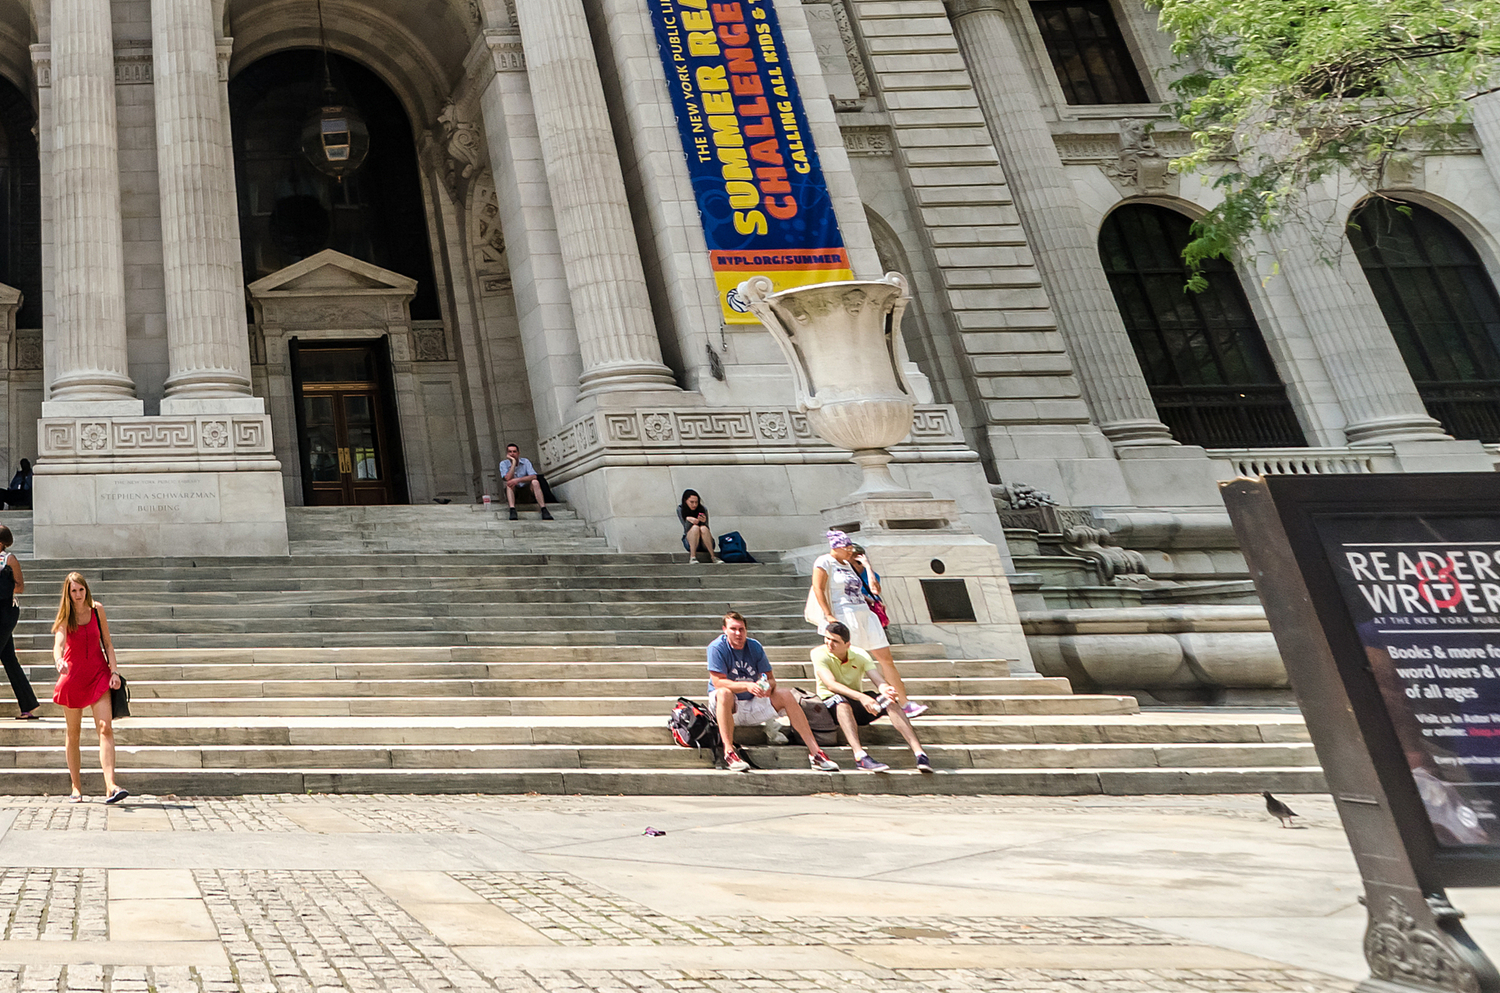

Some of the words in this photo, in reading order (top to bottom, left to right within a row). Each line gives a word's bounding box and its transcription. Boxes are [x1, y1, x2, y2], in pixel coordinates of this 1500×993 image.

[751, 7, 766, 20] &
[664, 17, 685, 61] PUBLIC
[755, 23, 779, 63] KIDS
[676, 65, 695, 99] YORK
[768, 66, 788, 97] ALL
[686, 102, 705, 133] NEW
[711, 2, 798, 220] CHALLENGE
[694, 137, 712, 163] THE
[696, 65, 768, 236] SUMMER
[777, 101, 811, 174] CALLING
[717, 254, 842, 265] NYPL.ORG/SUMMER
[151, 492, 216, 500] SCHWARZMAN
[1374, 617, 1387, 625] AT
[1389, 617, 1411, 625] THE
[1413, 617, 1437, 625] NEW
[1440, 616, 1470, 624] YORK
[1387, 644, 1433, 659] Books
[1432, 645, 1448, 659] &
[1447, 647, 1487, 659] more
[1395, 664, 1436, 679] word
[1433, 664, 1481, 679] lovers
[1481, 664, 1496, 678] &
[1405, 683, 1422, 698] of
[1423, 683, 1443, 698] all
[1443, 687, 1479, 703] ages
